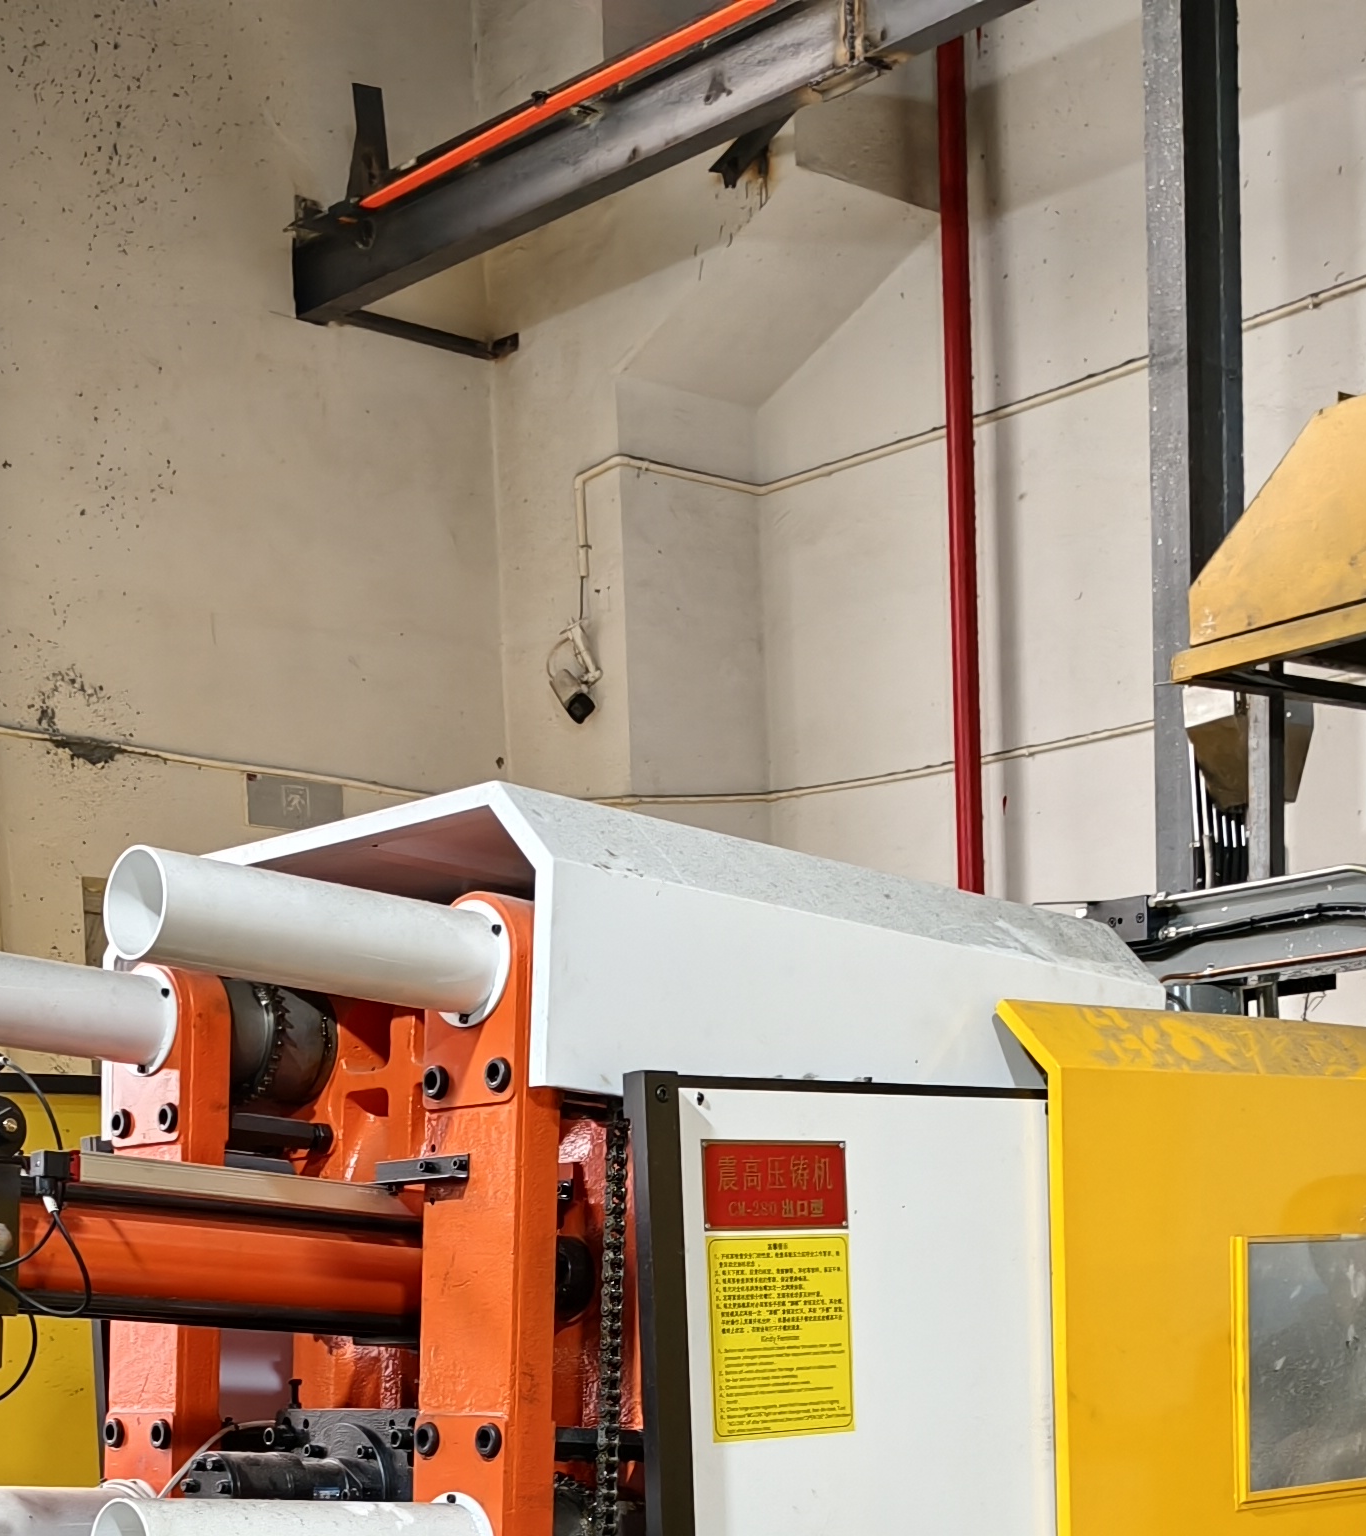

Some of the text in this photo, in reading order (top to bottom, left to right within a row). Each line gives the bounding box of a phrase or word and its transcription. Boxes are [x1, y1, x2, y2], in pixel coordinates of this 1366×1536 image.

[717, 1155, 834, 1191] 震高压铸机
[782, 1198, 824, 1218] 出口型
